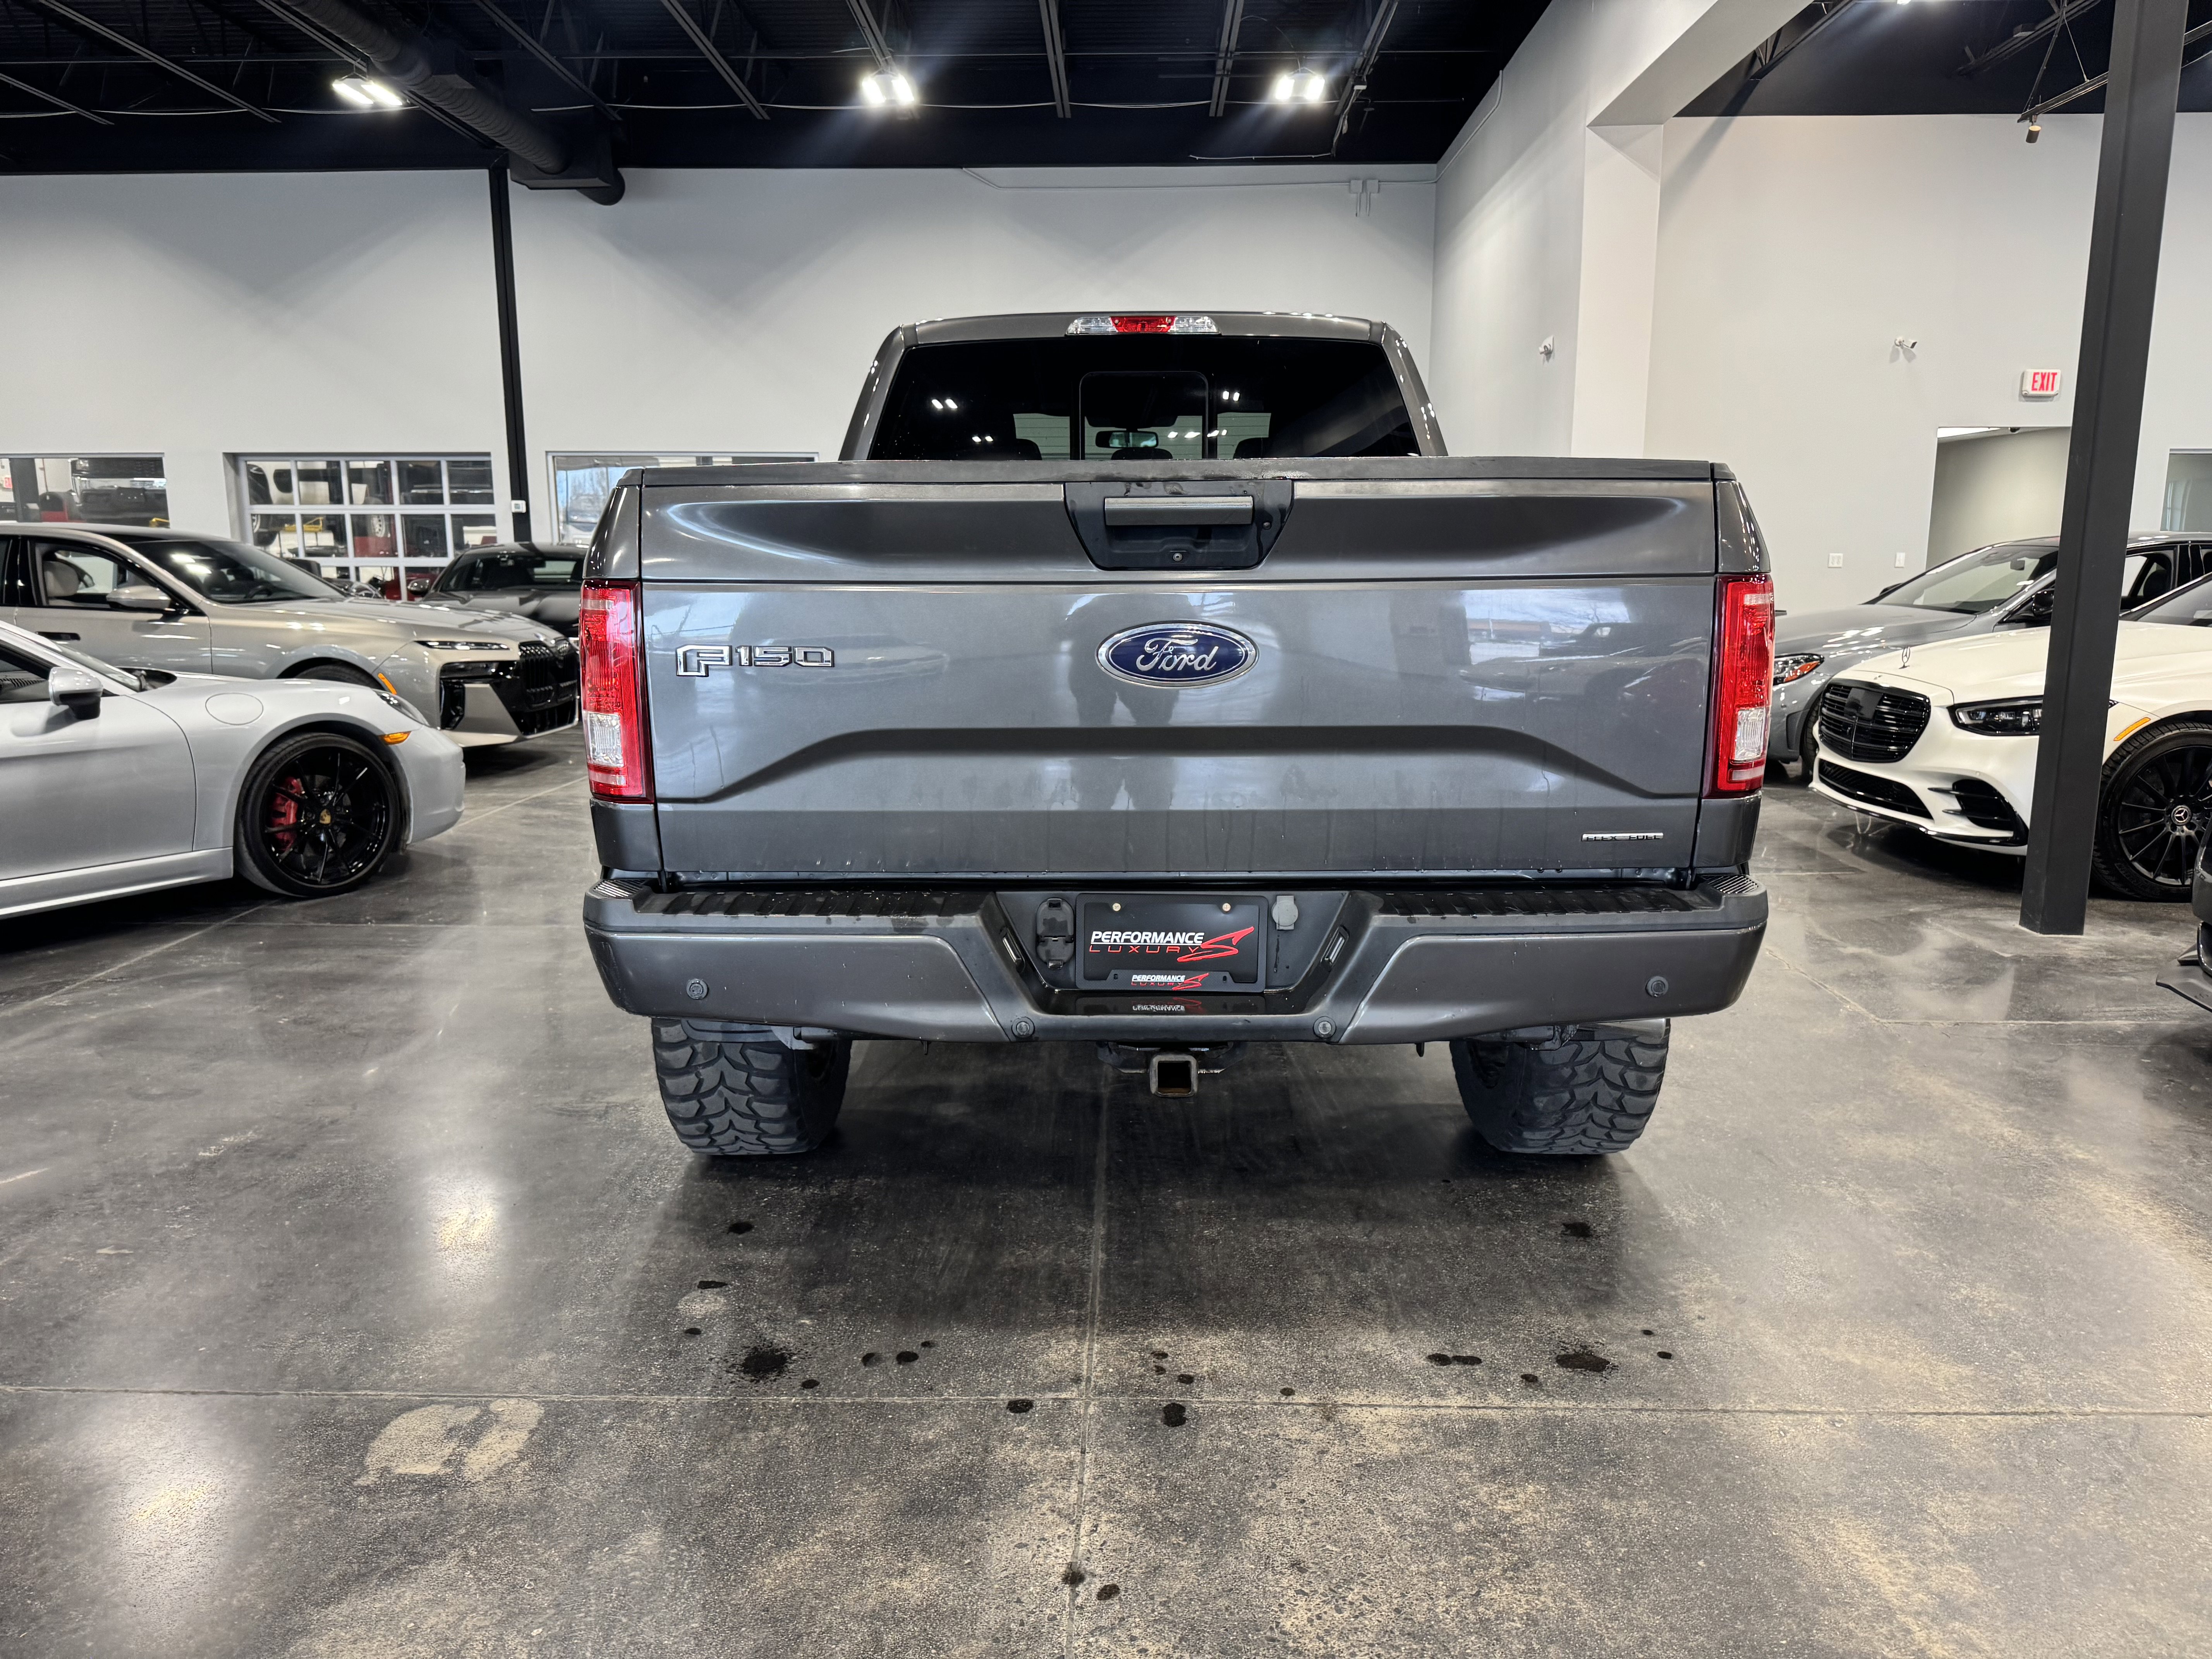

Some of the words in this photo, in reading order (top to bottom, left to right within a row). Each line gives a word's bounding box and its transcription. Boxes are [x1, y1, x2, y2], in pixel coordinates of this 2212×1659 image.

[2031, 372, 2057, 391] EXIT
[1135, 637, 1219, 672] Ford
[1091, 931, 1205, 944] PERFORMANCE
